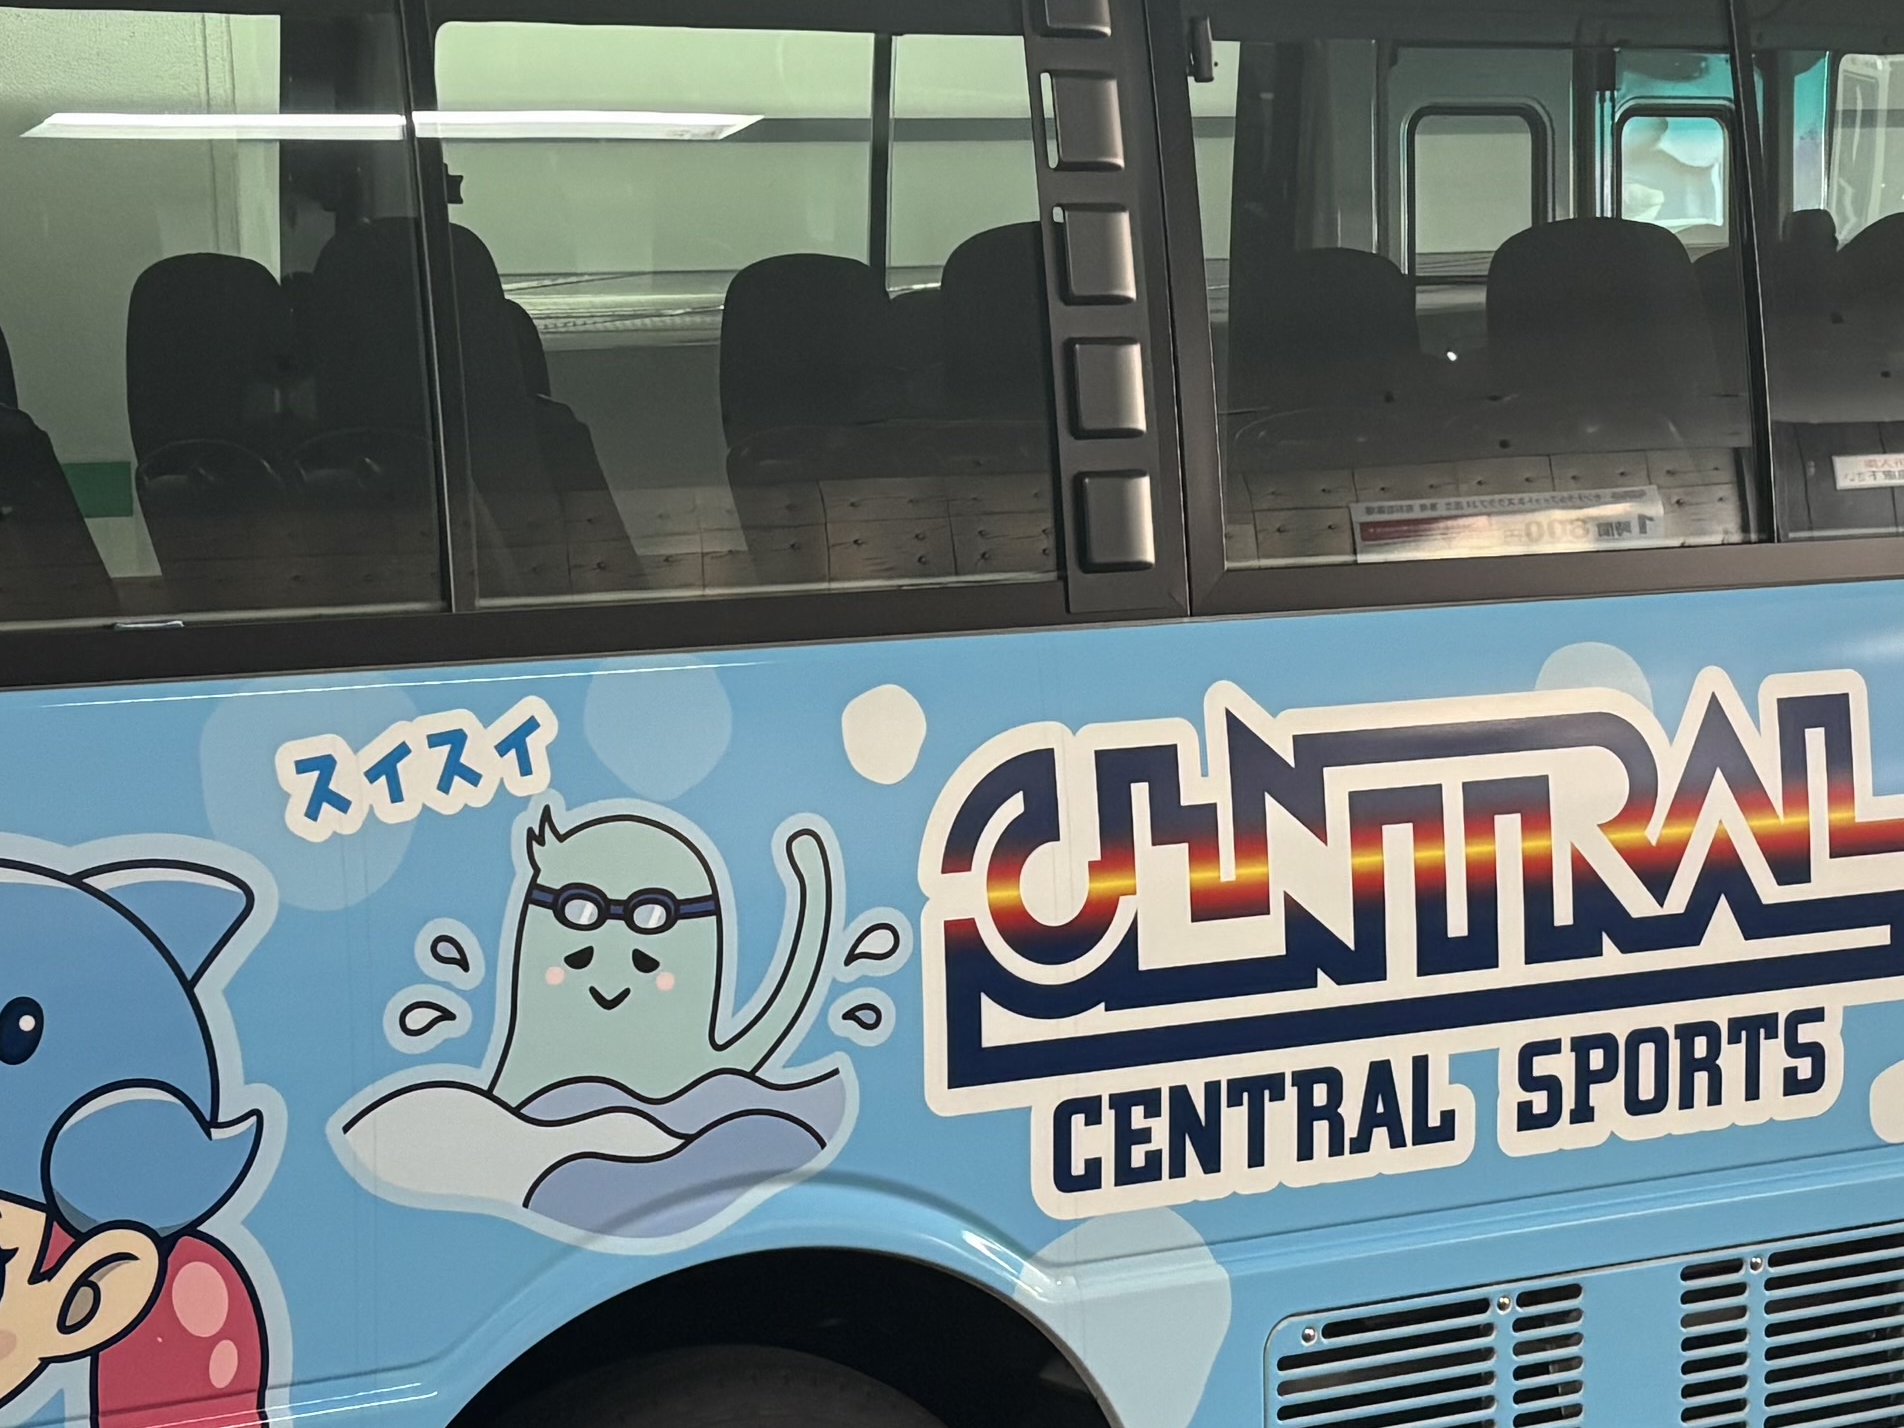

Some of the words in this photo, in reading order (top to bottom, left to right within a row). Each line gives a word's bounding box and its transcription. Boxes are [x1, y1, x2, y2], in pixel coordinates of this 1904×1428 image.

[293, 714, 542, 823] スイスイ
[1050, 1053, 1457, 1194] CENTRAL
[1515, 1005, 1827, 1132] SPORTS
